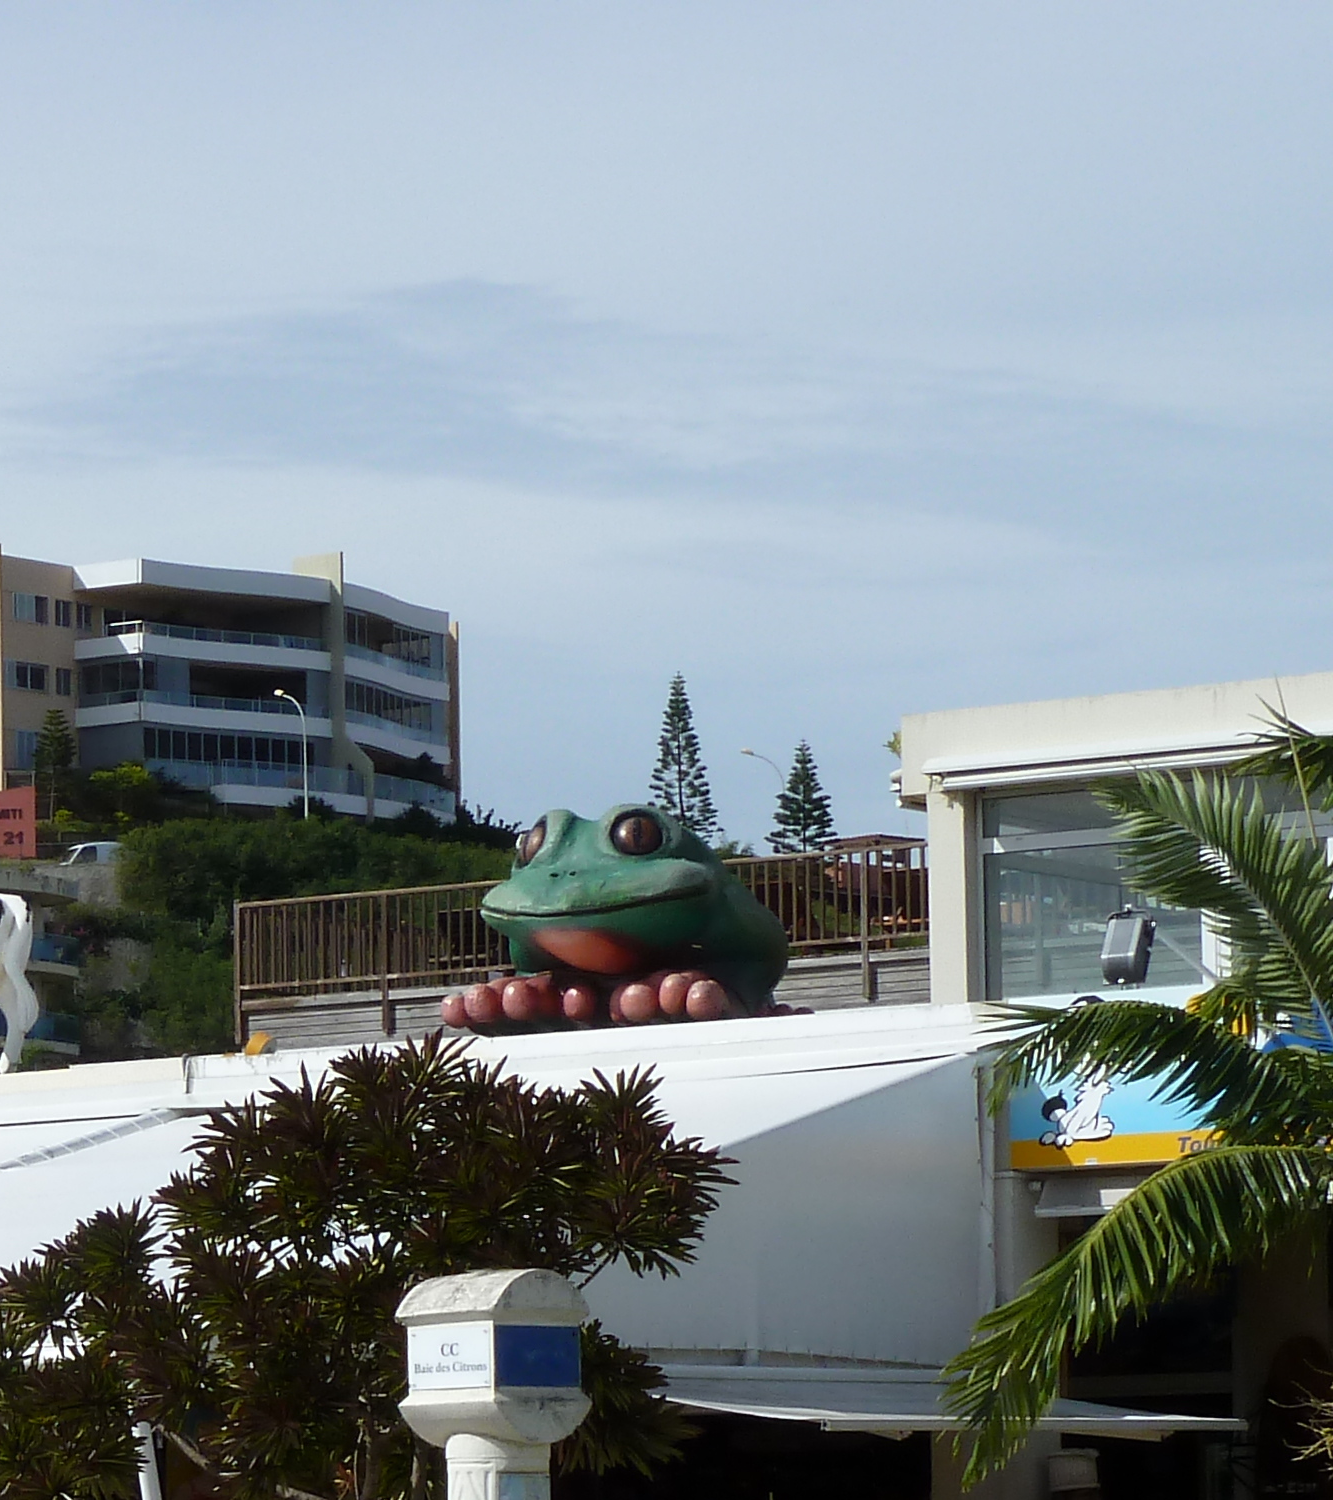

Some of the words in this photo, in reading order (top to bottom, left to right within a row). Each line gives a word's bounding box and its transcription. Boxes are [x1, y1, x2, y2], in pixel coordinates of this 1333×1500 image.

[3, 831, 24, 845] 21
[440, 1342, 459, 1357] CC
[414, 1363, 434, 1375] Baie
[435, 1362, 451, 1373] des
[452, 1361, 488, 1372] Citrons
